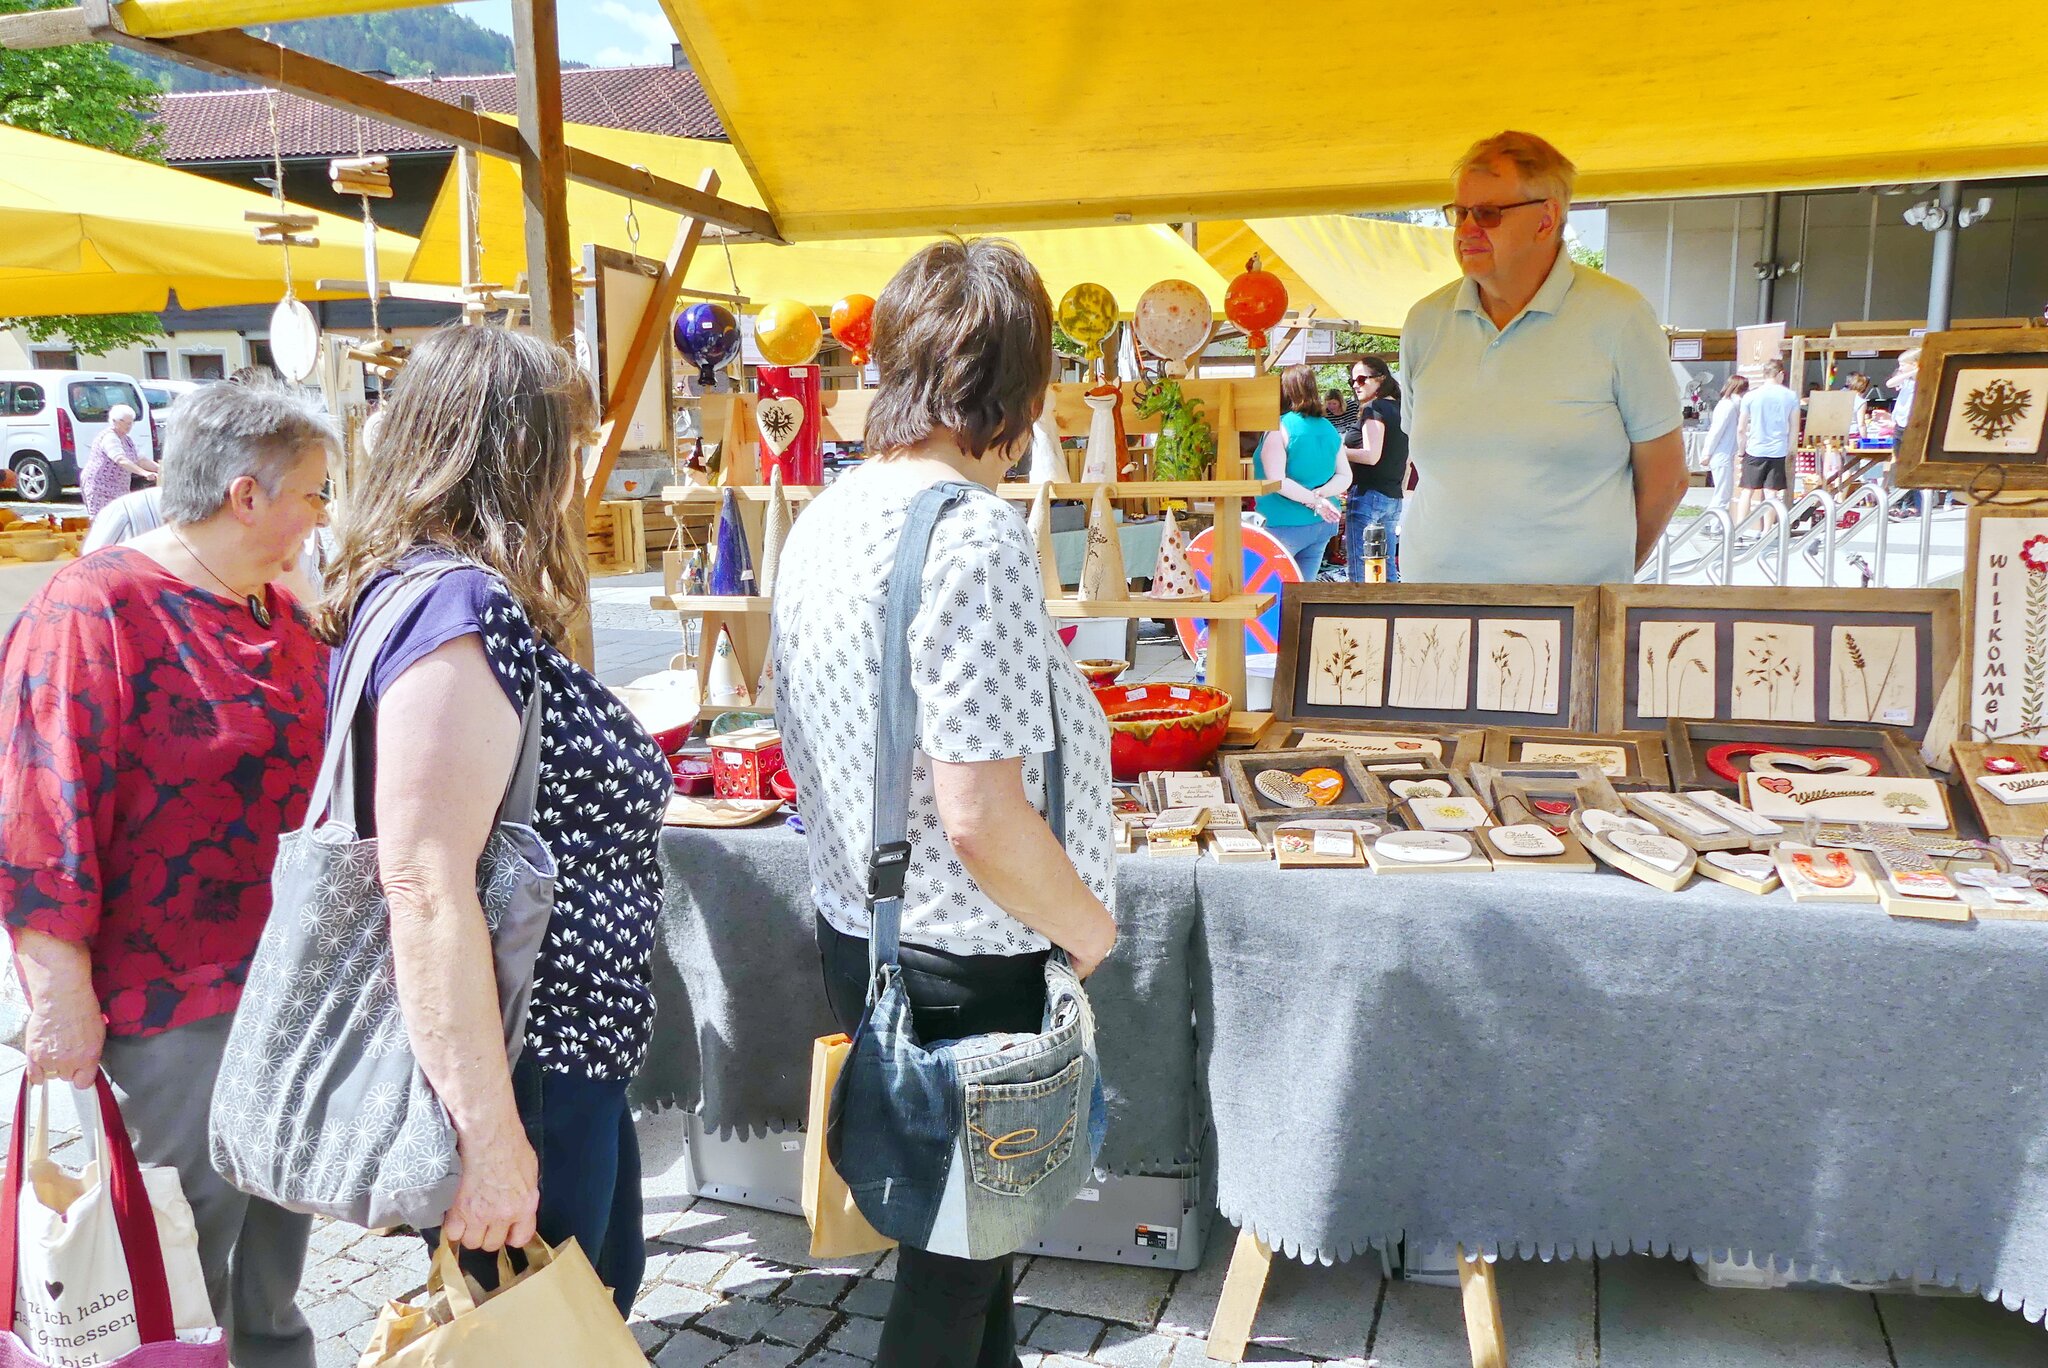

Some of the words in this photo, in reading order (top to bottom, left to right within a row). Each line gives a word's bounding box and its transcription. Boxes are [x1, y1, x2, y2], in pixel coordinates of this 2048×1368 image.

[1999, 778, 2048, 793] Willko
[1788, 788, 1875, 805] Willkommen
[44, 1308, 72, 1325] ich
[77, 1288, 130, 1322] habe
